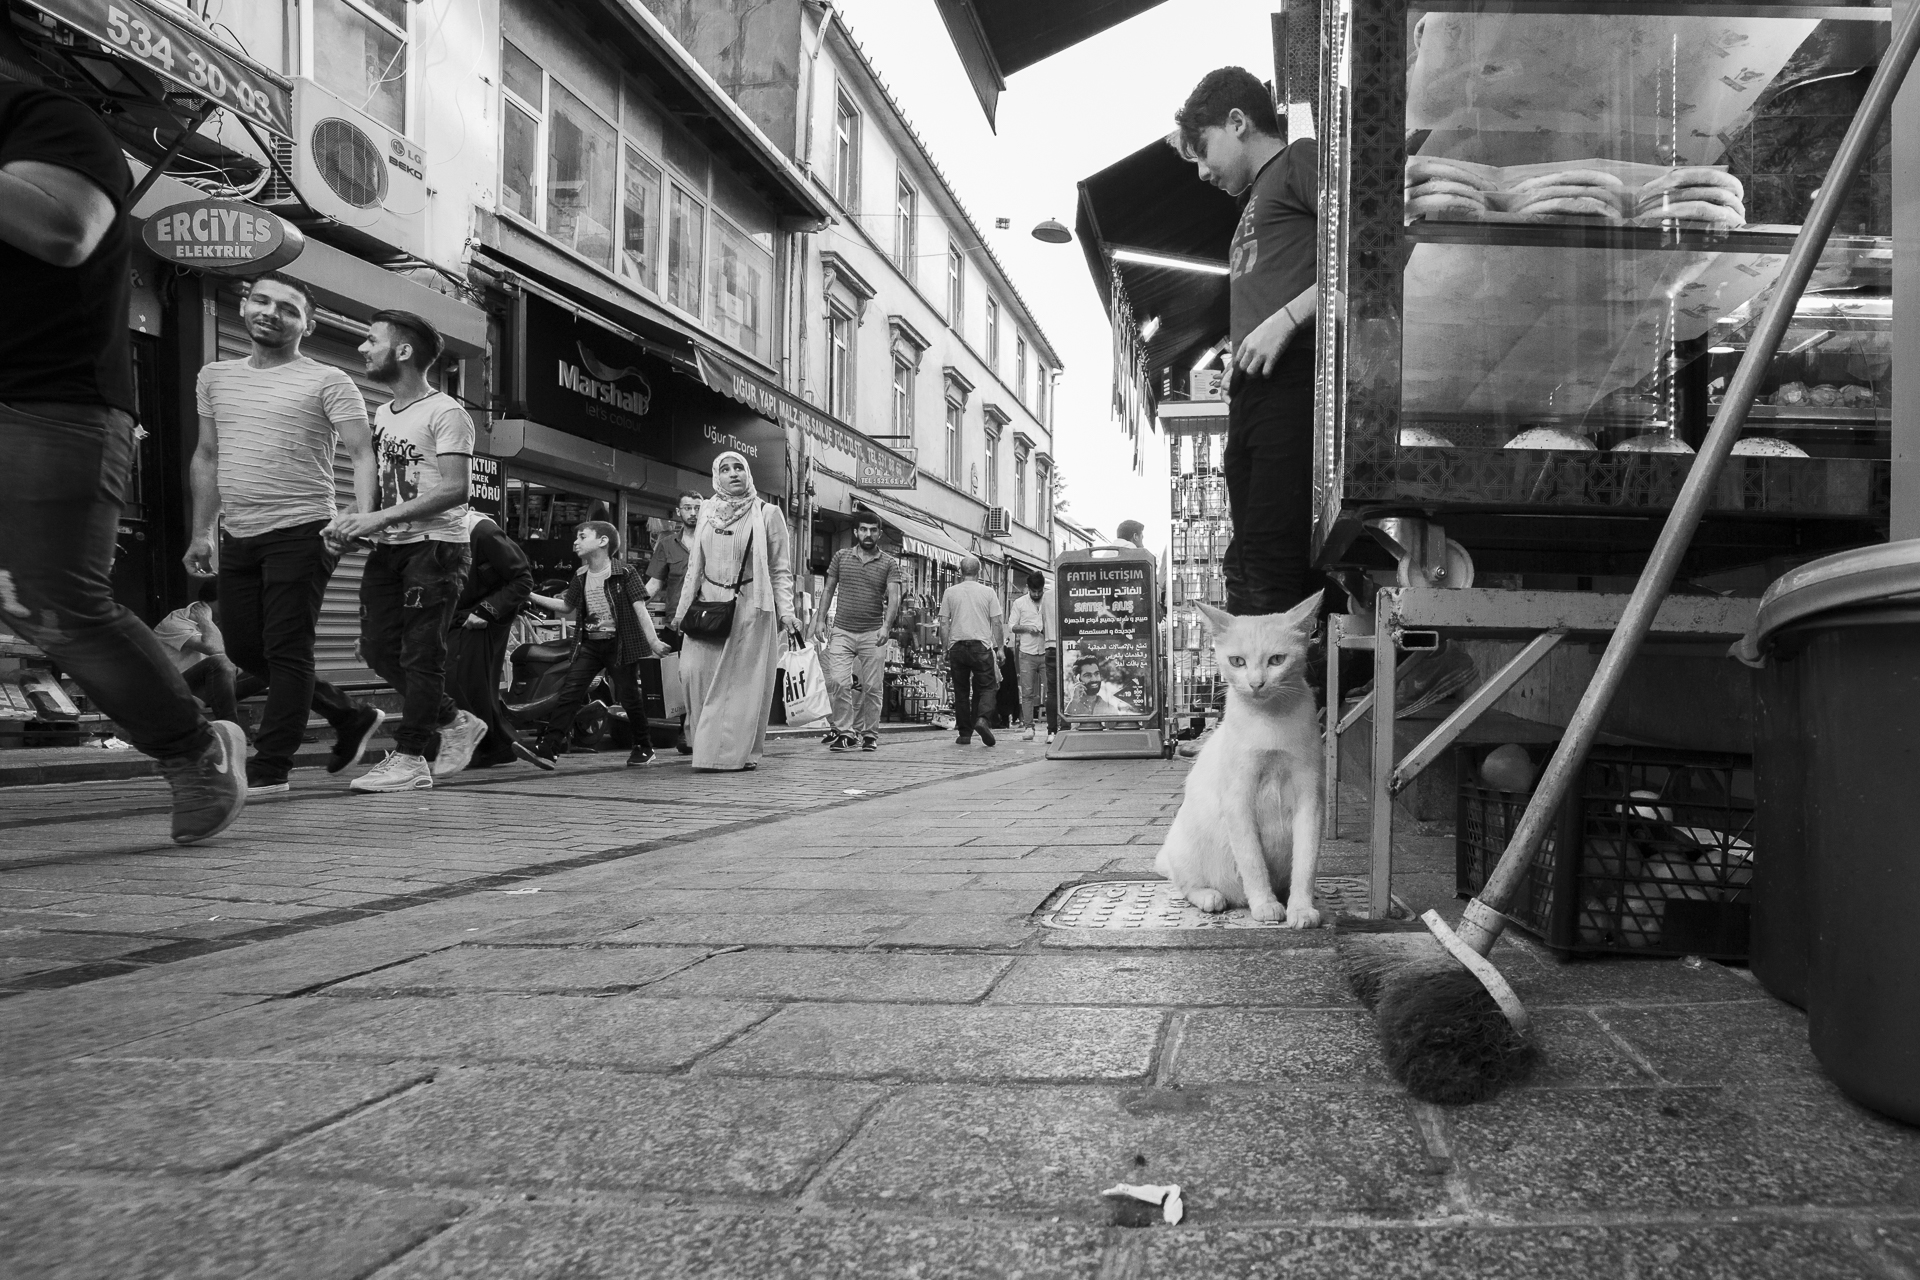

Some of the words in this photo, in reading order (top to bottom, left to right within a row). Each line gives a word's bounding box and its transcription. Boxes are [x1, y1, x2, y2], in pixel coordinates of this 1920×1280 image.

[106, 5, 174, 71] 534
[187, 52, 226, 97] 30
[236, 80, 273, 123] 03
[389, 155, 422, 180] BEKO
[408, 149, 421, 165] LG
[559, 359, 644, 416] Marshall
[733, 374, 756, 404] UĞUR
[759, 388, 776, 414] YAPI
[704, 424, 726, 444] Uğur
[728, 434, 758, 458] Ticaret
[472, 457, 498, 475] KTUR
[472, 473, 489, 484] RKEK
[470, 484, 500, 502] AFÖRÜ
[1114, 586, 1142, 598] الفاتح
